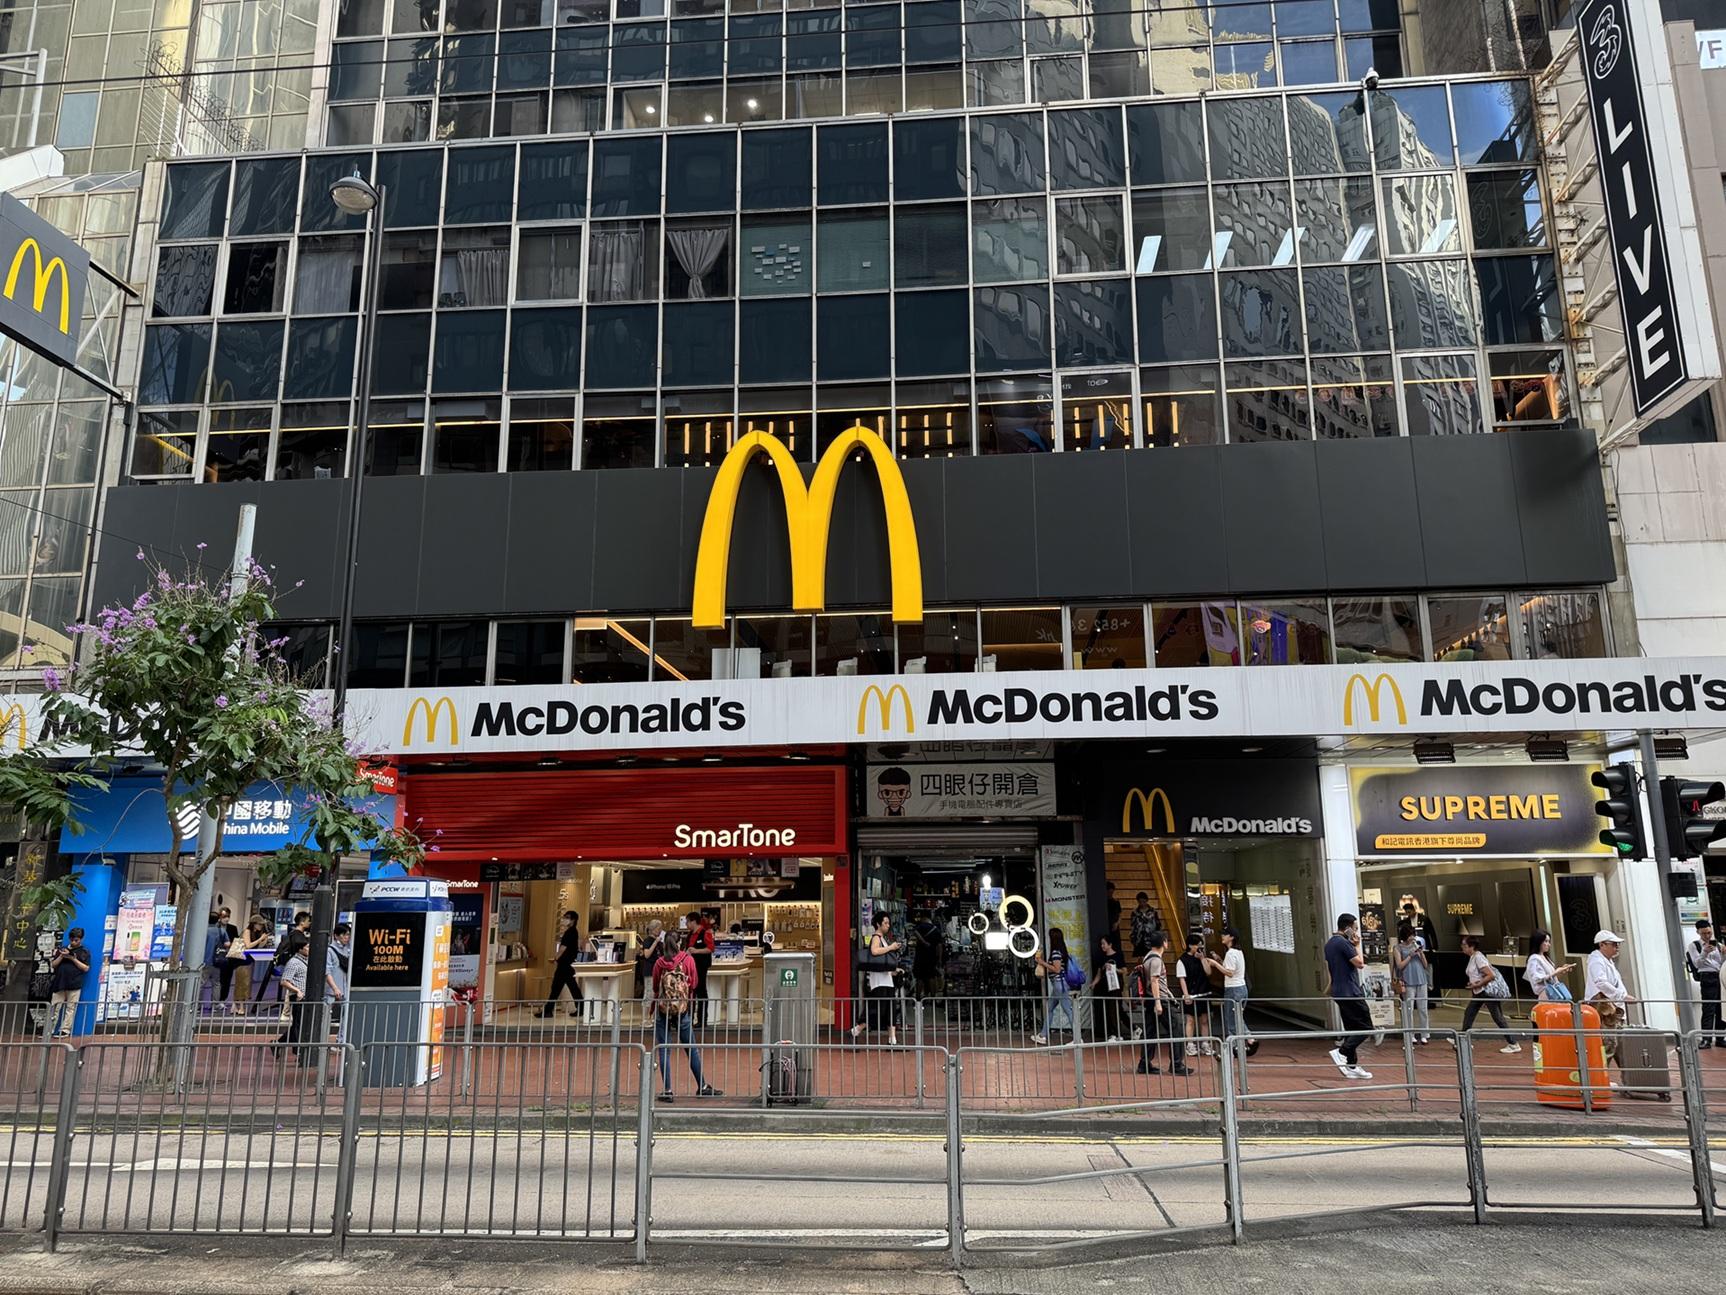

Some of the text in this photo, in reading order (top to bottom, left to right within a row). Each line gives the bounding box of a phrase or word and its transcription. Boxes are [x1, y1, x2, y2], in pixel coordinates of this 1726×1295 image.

[1602, 98, 1670, 380] LIVE
[927, 684, 1219, 724] McDonald's
[1420, 673, 1726, 717] McDonald's
[470, 696, 746, 737] McDonald's
[920, 772, 1039, 796] 四眼仔開倉
[1399, 793, 1562, 821] SUPREME
[223, 822, 290, 835] hina Mobile
[673, 823, 796, 848] SmarTone
[1190, 817, 1312, 834] McDonald's
[1446, 903, 1474, 916] SUPREME
[369, 928, 412, 945] Wi-Fi
[373, 945, 404, 954] 100M
